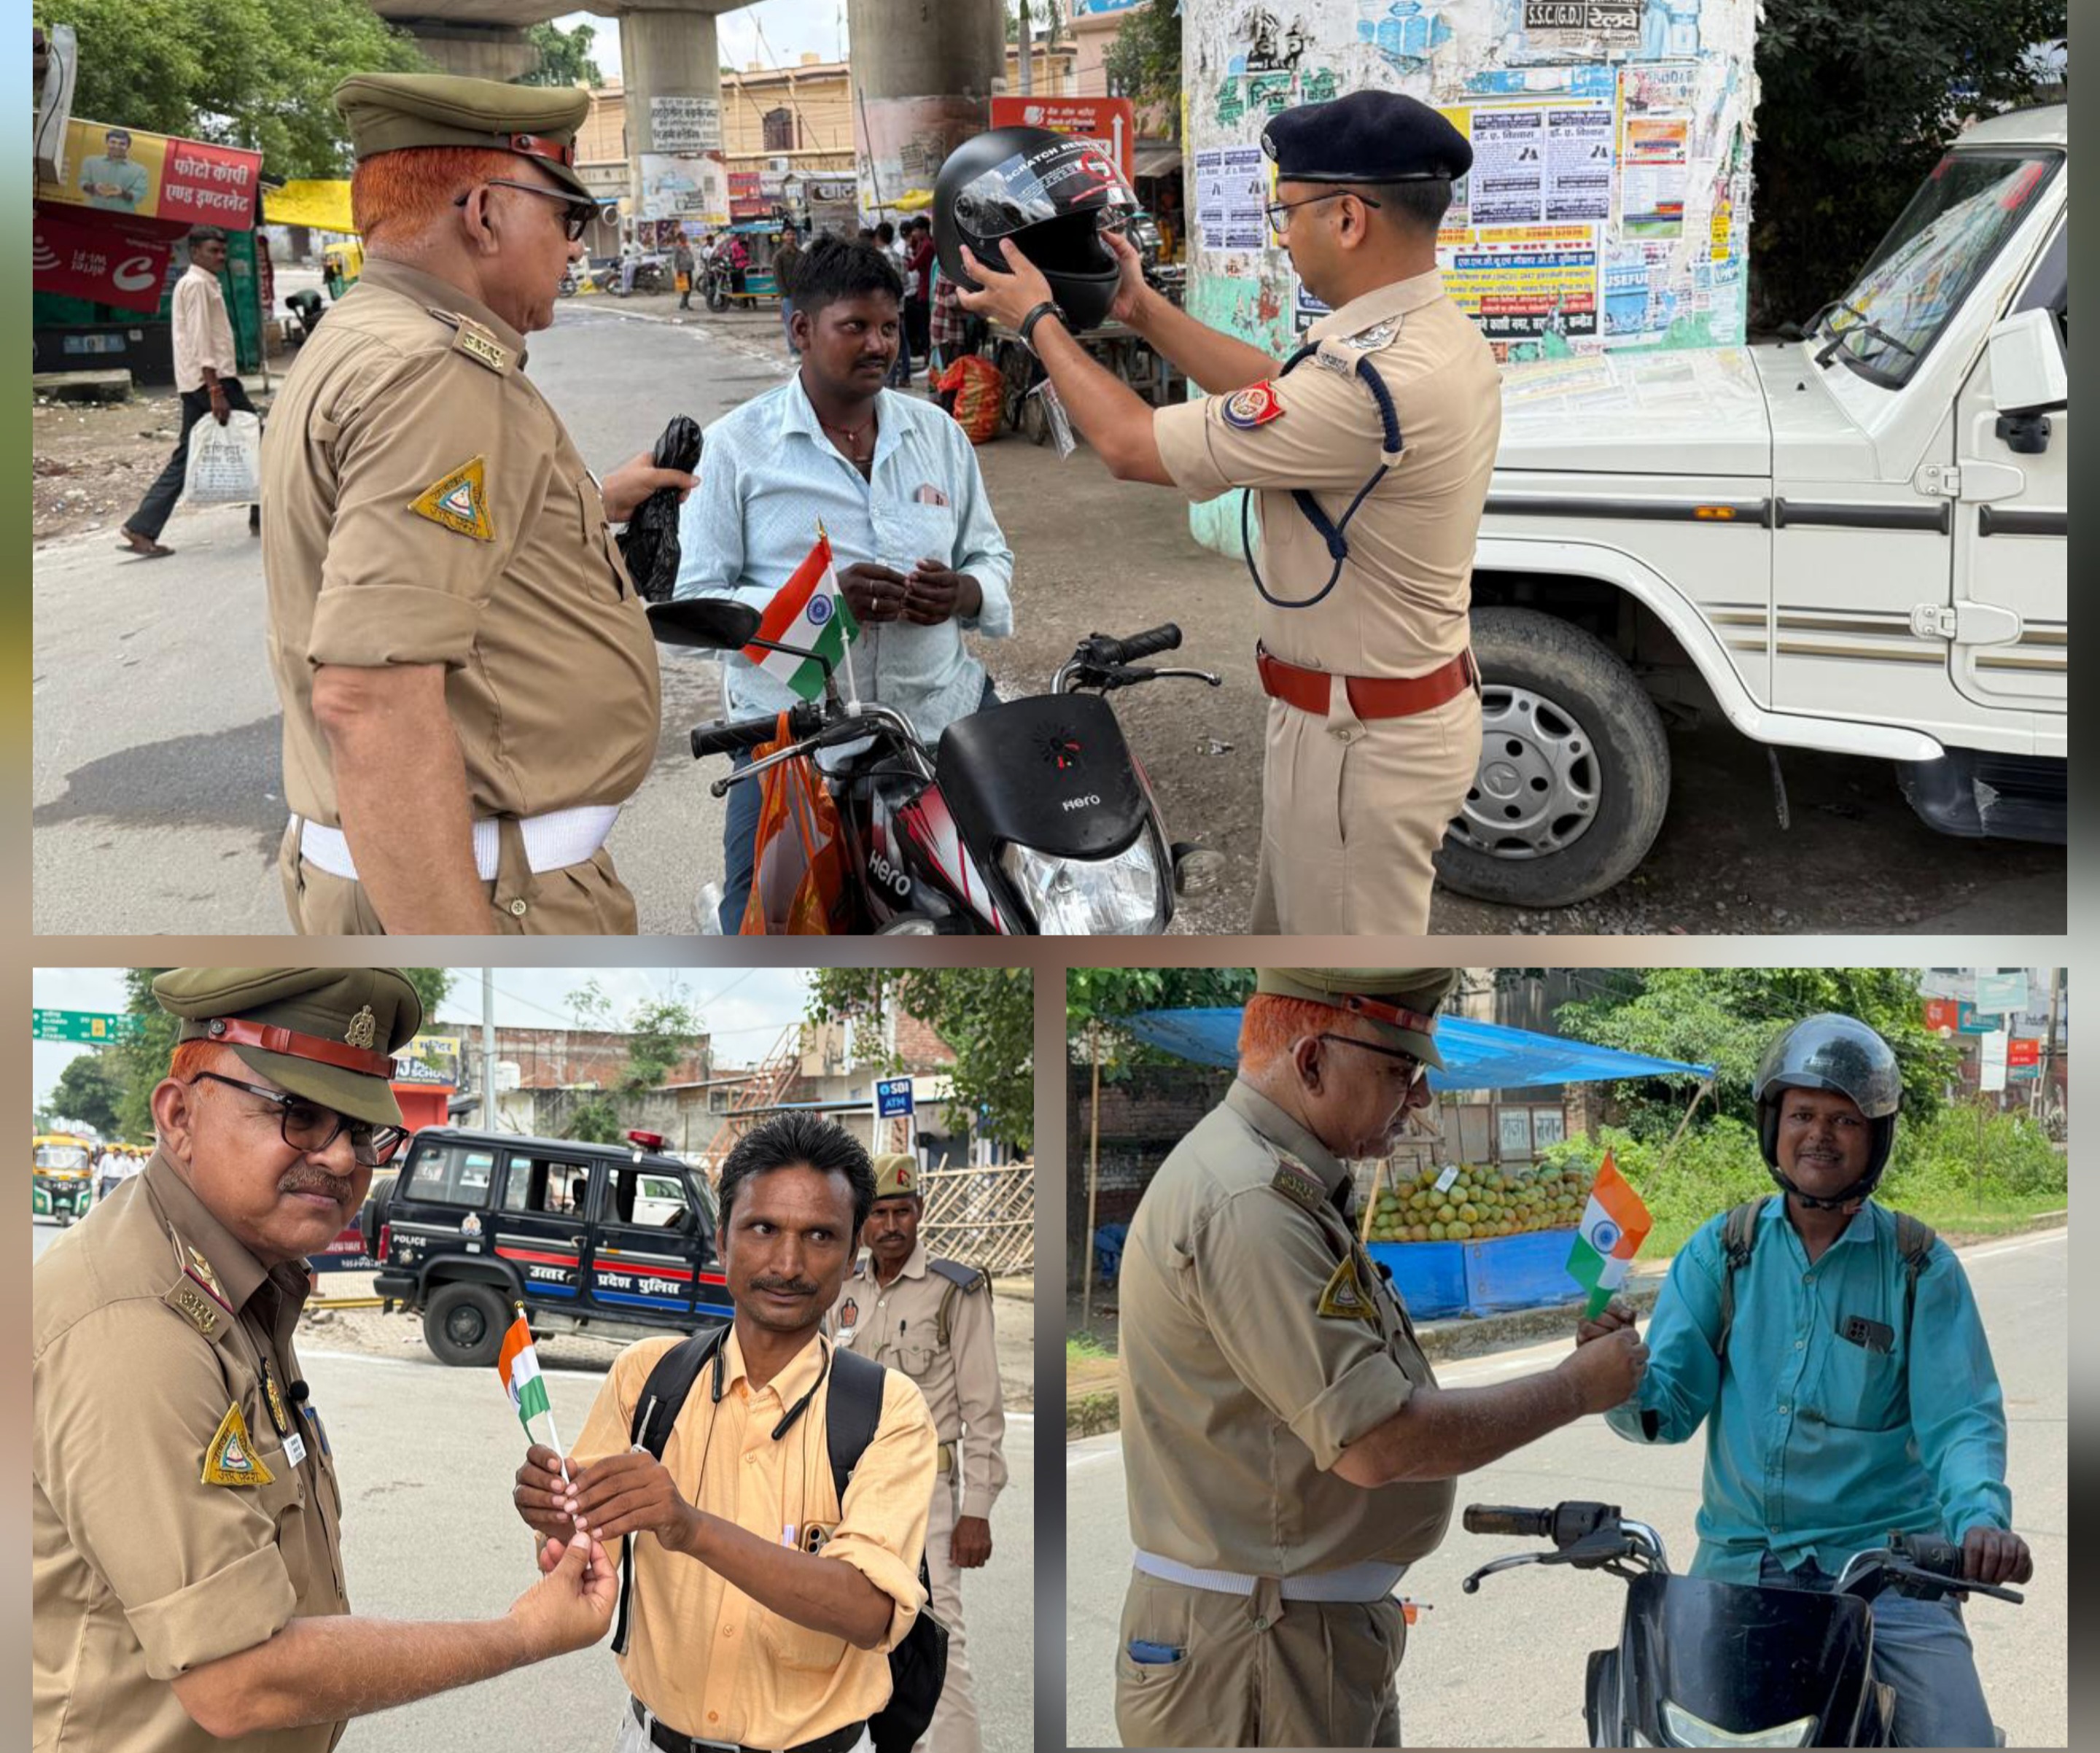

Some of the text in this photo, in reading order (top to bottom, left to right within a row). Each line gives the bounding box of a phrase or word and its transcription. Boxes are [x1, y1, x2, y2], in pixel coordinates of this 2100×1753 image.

[1589, 7, 1637, 28] रेलवे
[174, 156, 249, 186] फोटो कॉपी
[1006, 147, 1058, 183] SCRATCH
[166, 184, 193, 203] एण्ड
[884, 1097, 906, 1108] ATM
[393, 1234, 427, 1247] POLICE
[529, 1265, 680, 1294] उत्तर प्रदेश पुलिस
